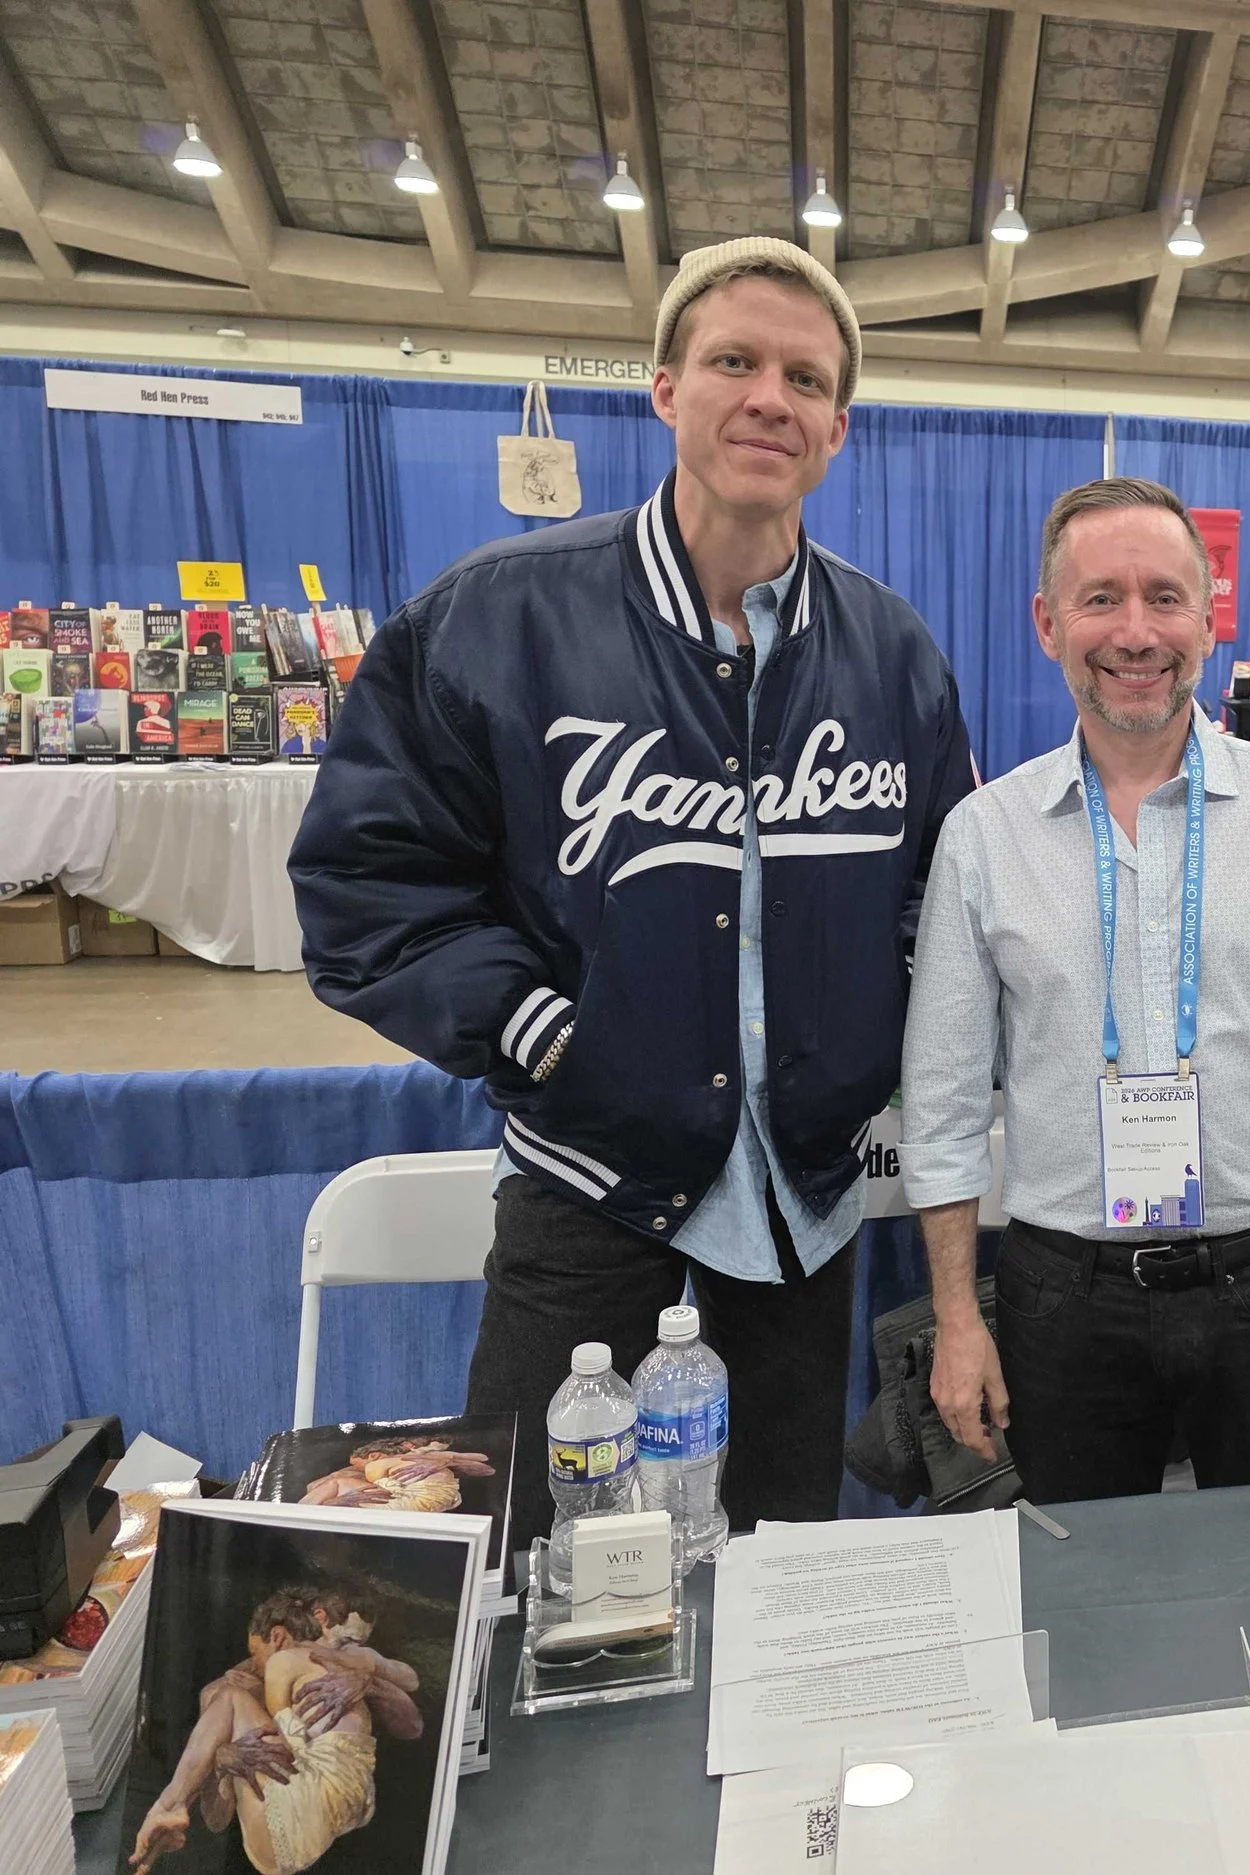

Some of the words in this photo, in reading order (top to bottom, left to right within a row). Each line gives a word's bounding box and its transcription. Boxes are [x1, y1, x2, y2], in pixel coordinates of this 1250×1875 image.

[141, 389, 157, 402] Red
[161, 391, 177, 402] Hen
[181, 393, 209, 405] Press
[54, 620, 75, 628] CITY
[148, 616, 177, 625] ANOTHER
[54, 629, 87, 637] SMOKE
[71, 637, 88, 645] SEA
[184, 699, 216, 707] MIRAGE
[545, 716, 907, 875] Yankees
[1191, 769, 1201, 817] WRITING
[1092, 800, 1103, 812] OF
[1191, 821, 1200, 829] &
[1096, 815, 1110, 856] WRITERS
[1188, 832, 1200, 879] WRITERS
[1101, 860, 1110, 868] &
[1102, 873, 1112, 921] WRITING
[1187, 883, 1197, 899] OF
[1184, 903, 1196, 984] ASSOCIATION
[1121, 1094, 1129, 1103] &
[1133, 1091, 1194, 1102] BOOKFAIR
[1142, 1115, 1176, 1123] Harmon
[607, 1550, 642, 1564] WTR
